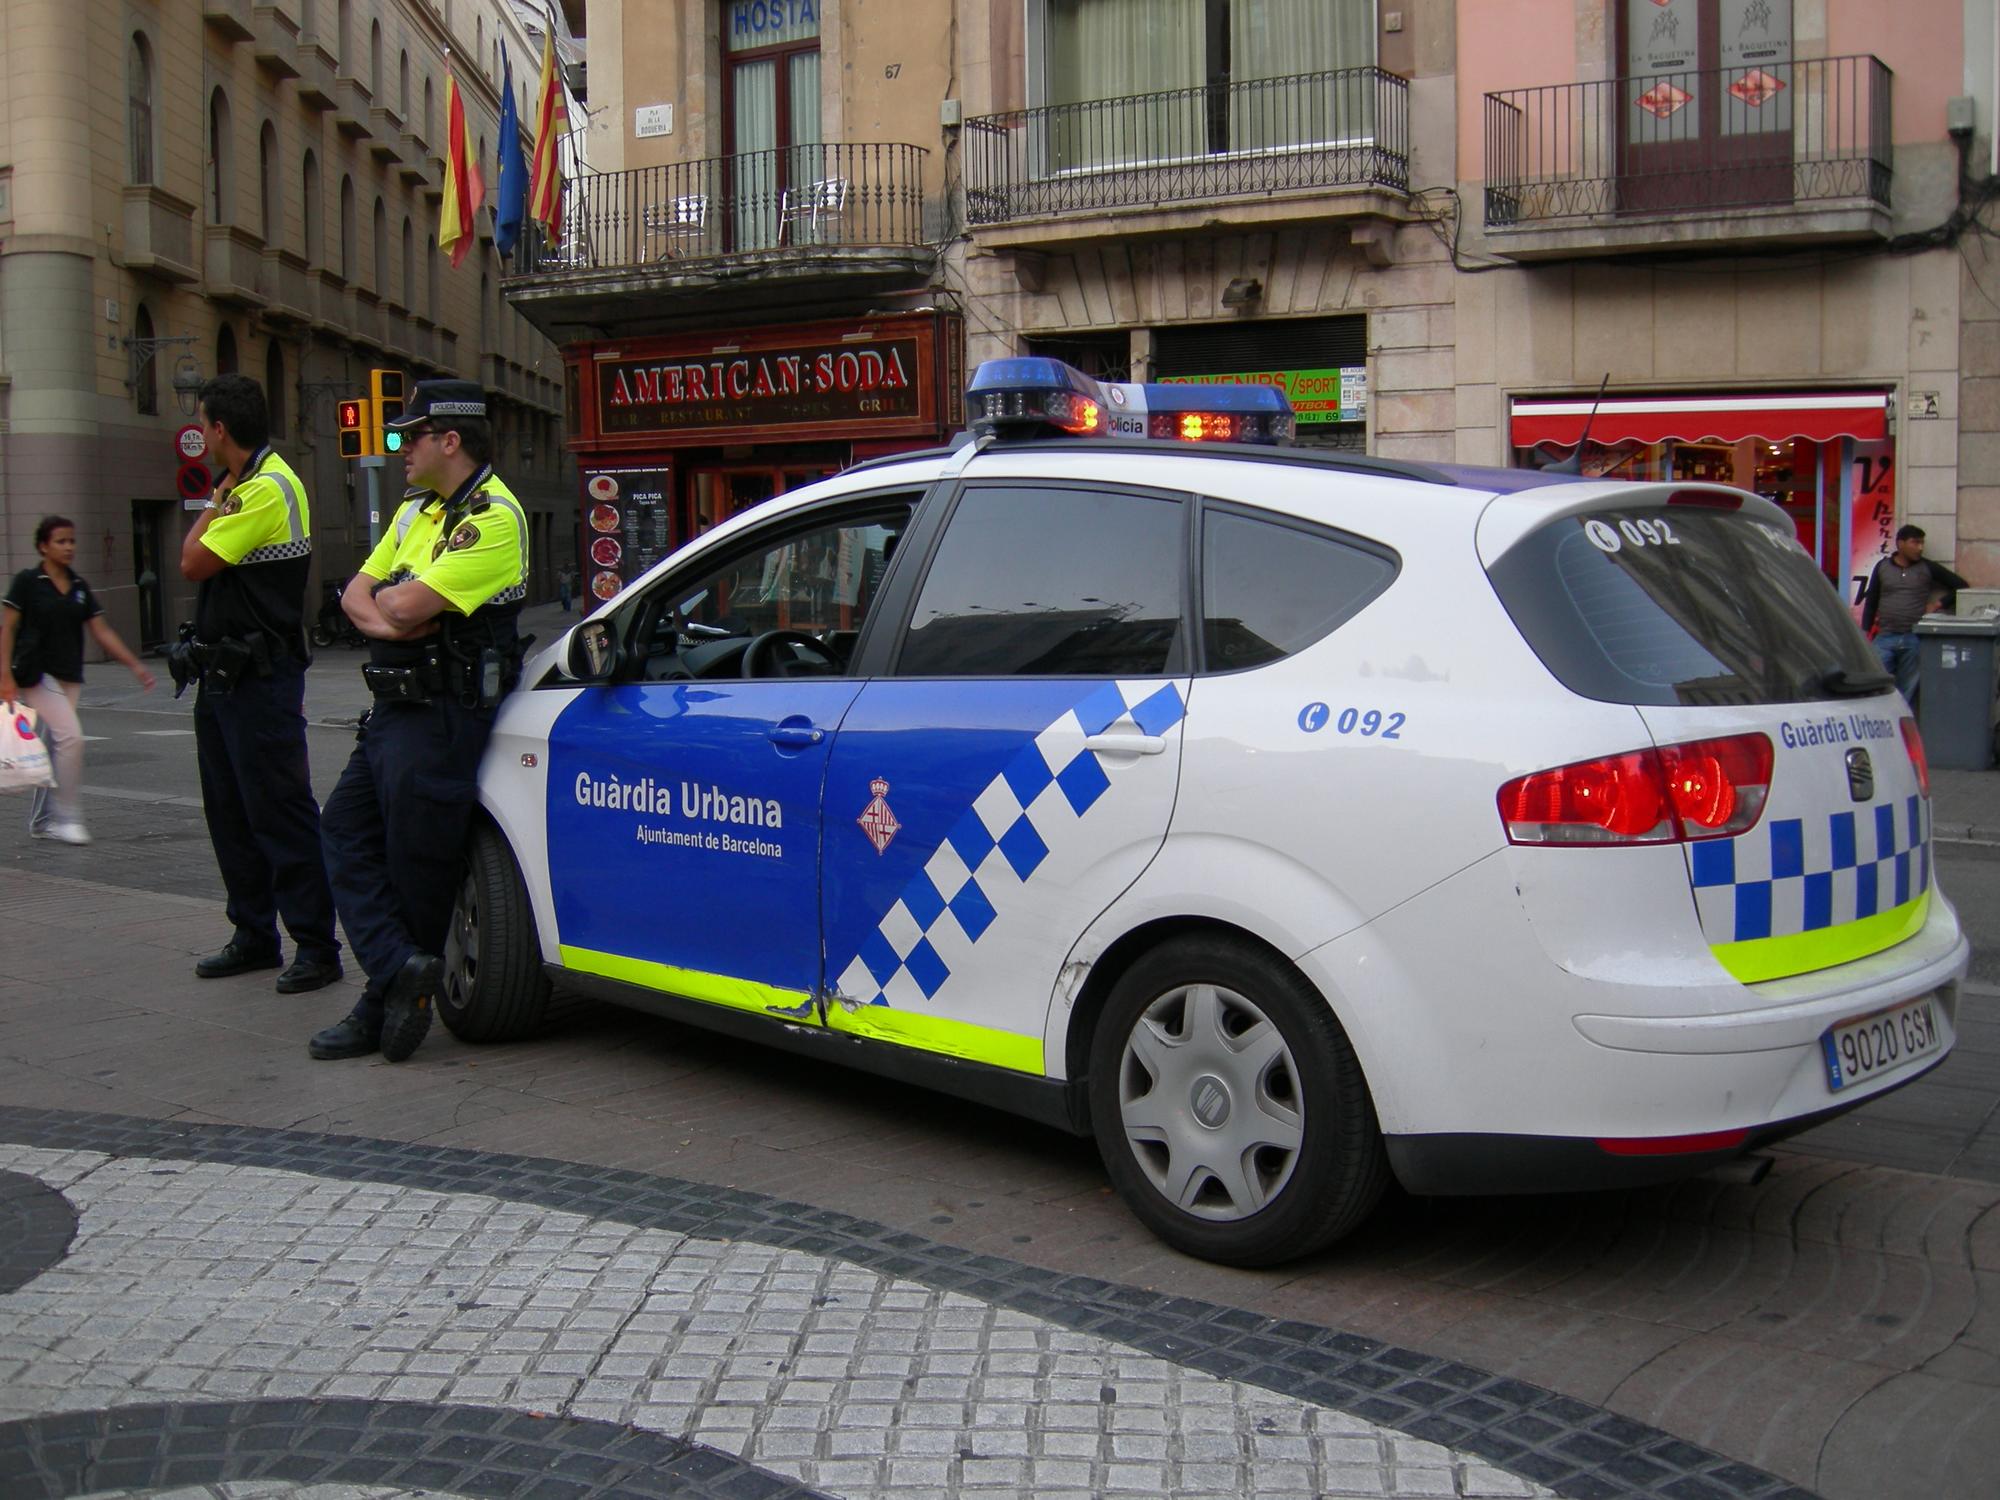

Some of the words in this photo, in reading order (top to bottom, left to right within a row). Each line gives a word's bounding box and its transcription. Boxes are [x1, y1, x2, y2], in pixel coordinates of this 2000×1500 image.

[885, 64, 902, 79] 67
[1291, 401, 1329, 409] UTBOL
[1326, 412, 1339, 421] 69
[1619, 518, 1680, 547] 092
[1337, 707, 1406, 740] 092
[1781, 718, 1849, 749] Guàrdia
[1850, 714, 1894, 740] Urbana
[575, 771, 671, 815] Guàrdia
[681, 782, 782, 828] Urbana
[637, 824, 703, 848] Ajuntament
[705, 832, 719, 849] de
[722, 833, 782, 857] Barcelona
[1842, 1019, 1899, 1076] 9020
[1901, 1002, 1936, 1054] GSW
